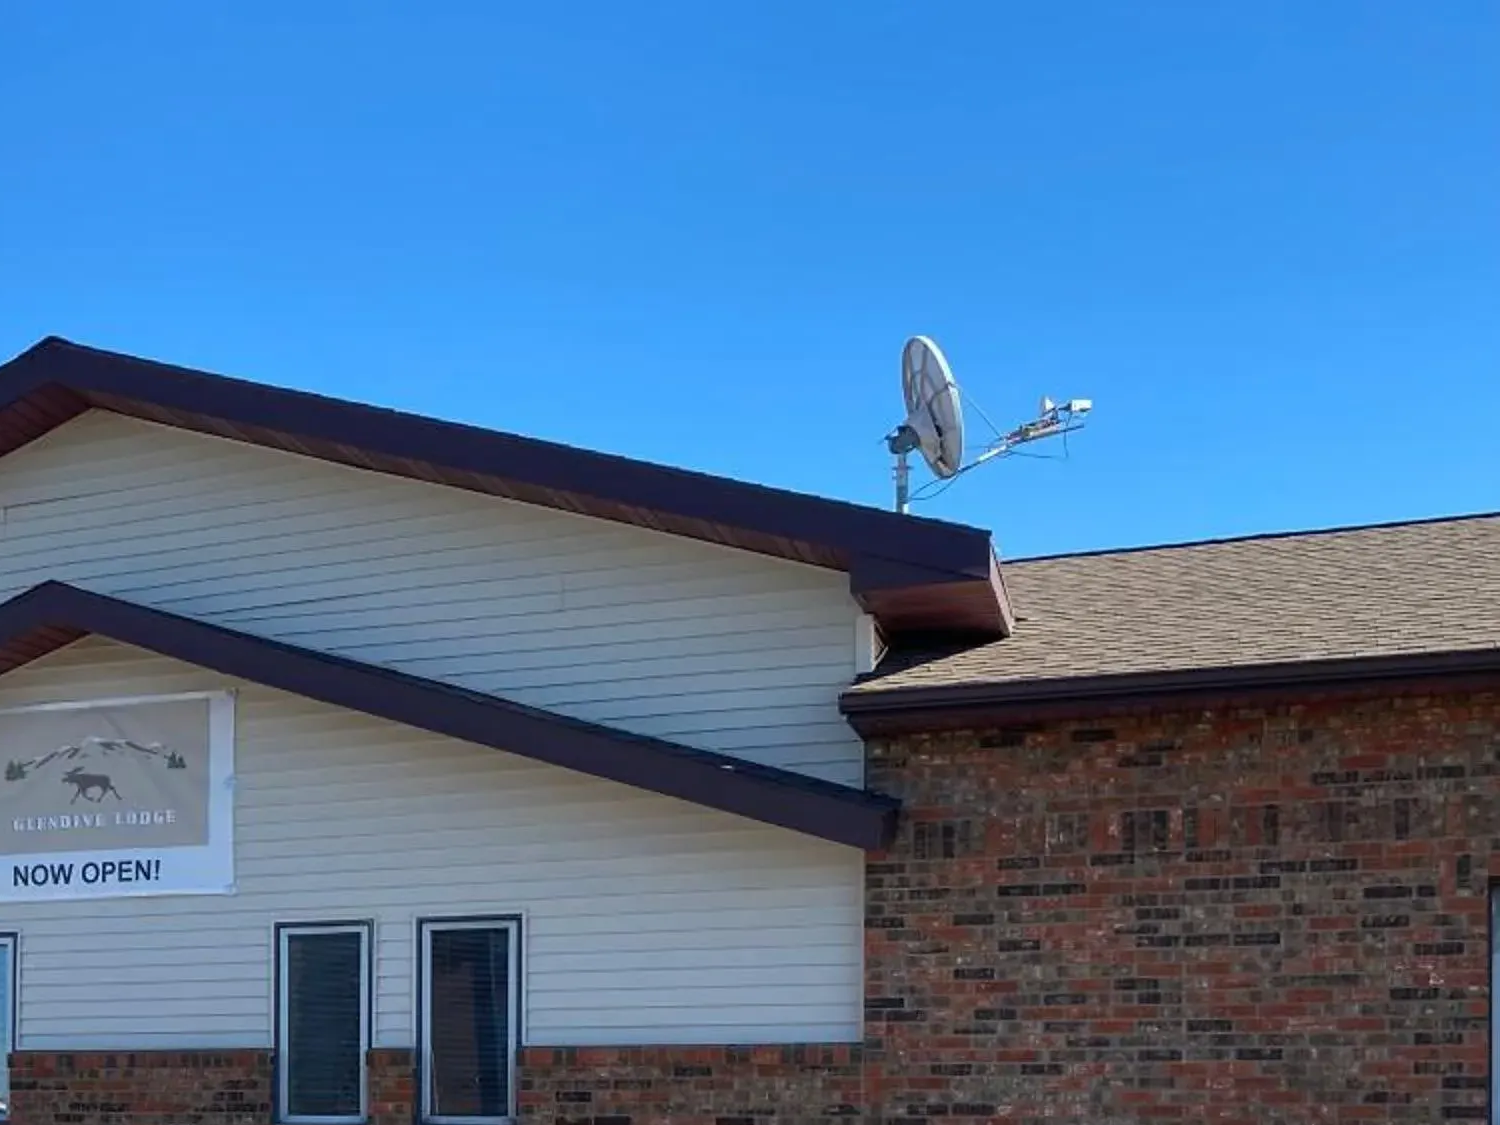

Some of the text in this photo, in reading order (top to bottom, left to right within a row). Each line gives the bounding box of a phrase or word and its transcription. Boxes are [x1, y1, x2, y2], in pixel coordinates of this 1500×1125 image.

[12, 809, 177, 832] GLENDIVE LODGE
[13, 859, 161, 887] NOW OPEN!
